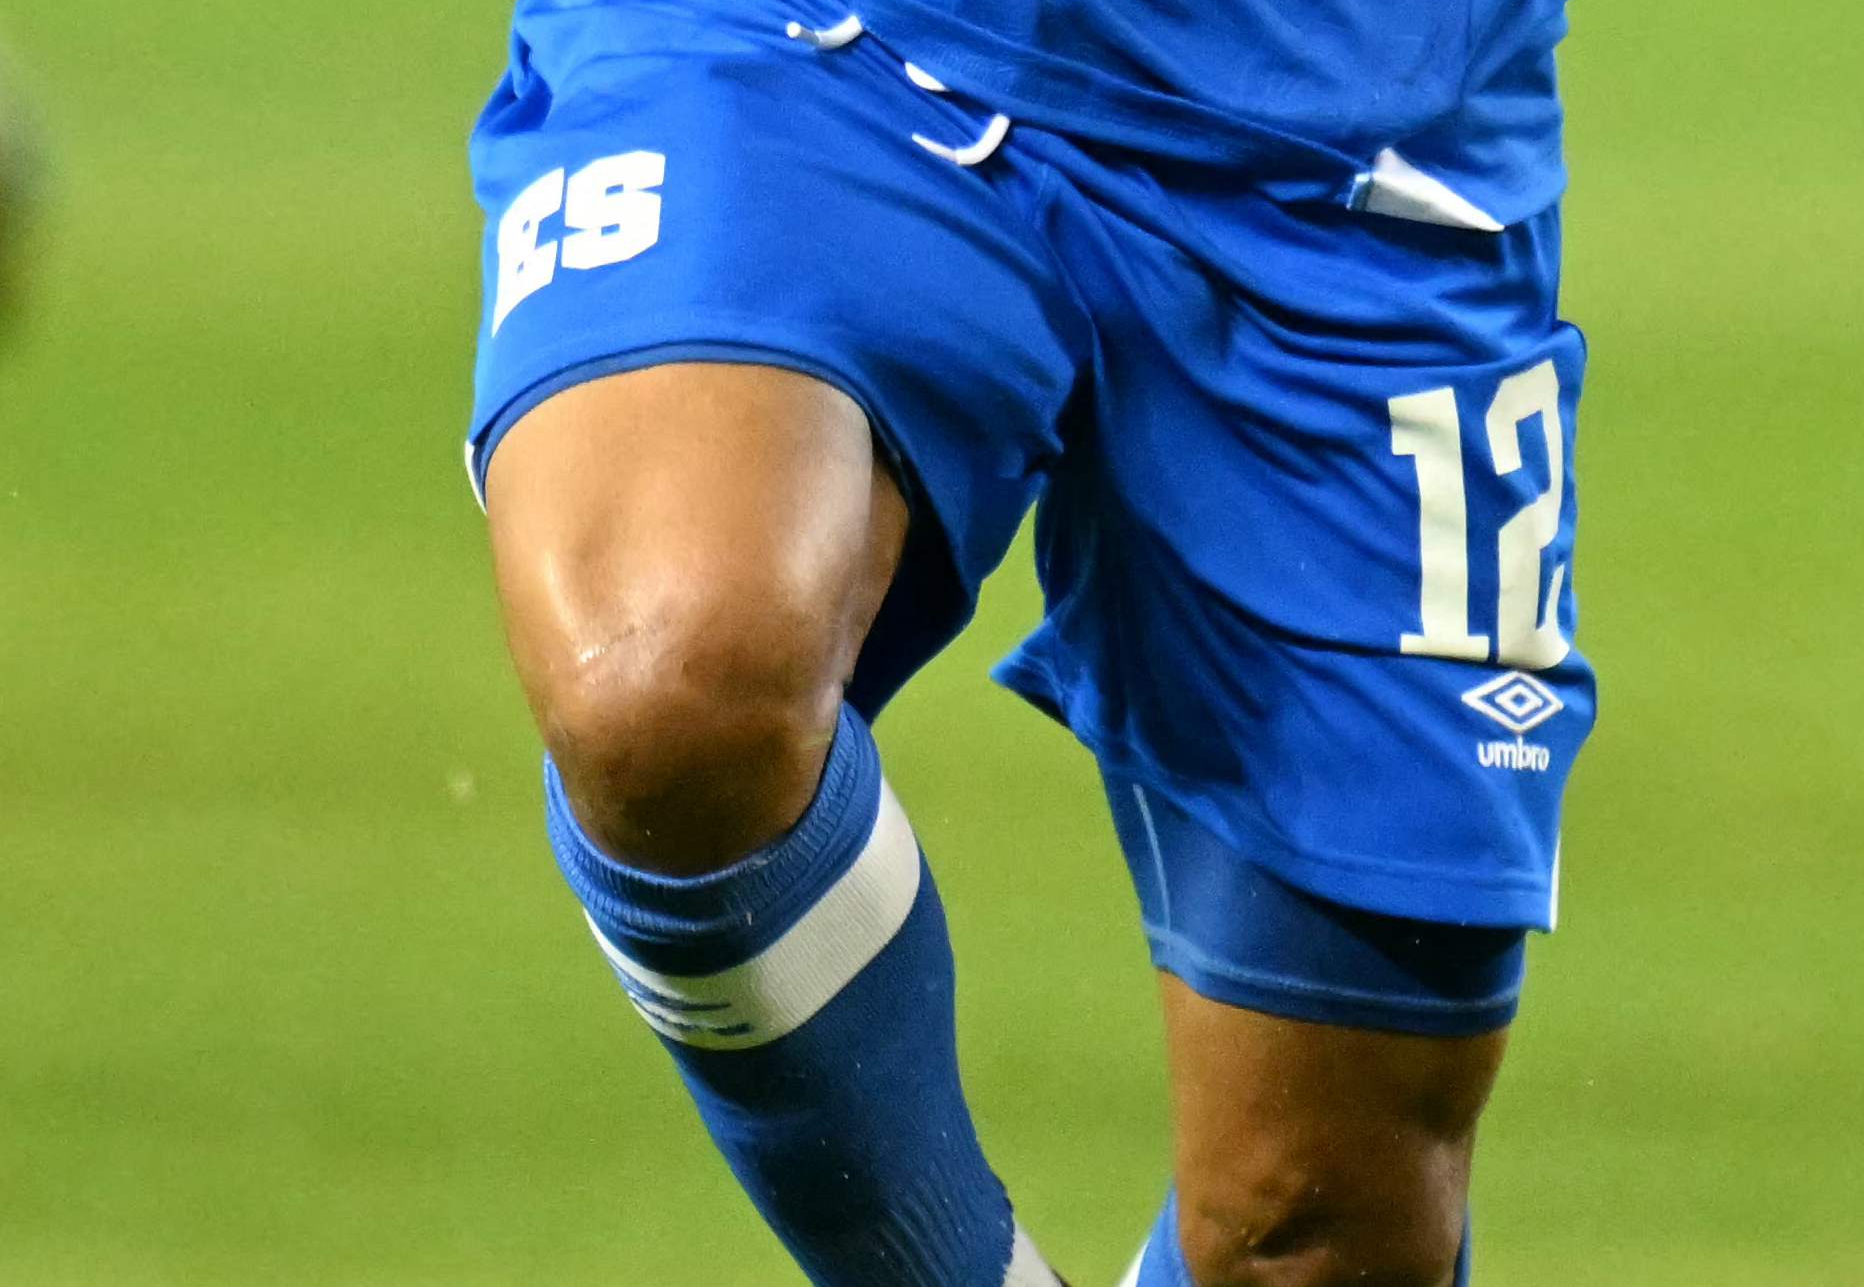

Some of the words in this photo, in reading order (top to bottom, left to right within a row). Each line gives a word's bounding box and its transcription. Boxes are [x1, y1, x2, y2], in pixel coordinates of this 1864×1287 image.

[491, 149, 666, 339] ES
[1387, 358, 1571, 672] 12
[1476, 736, 1551, 773] umbro
